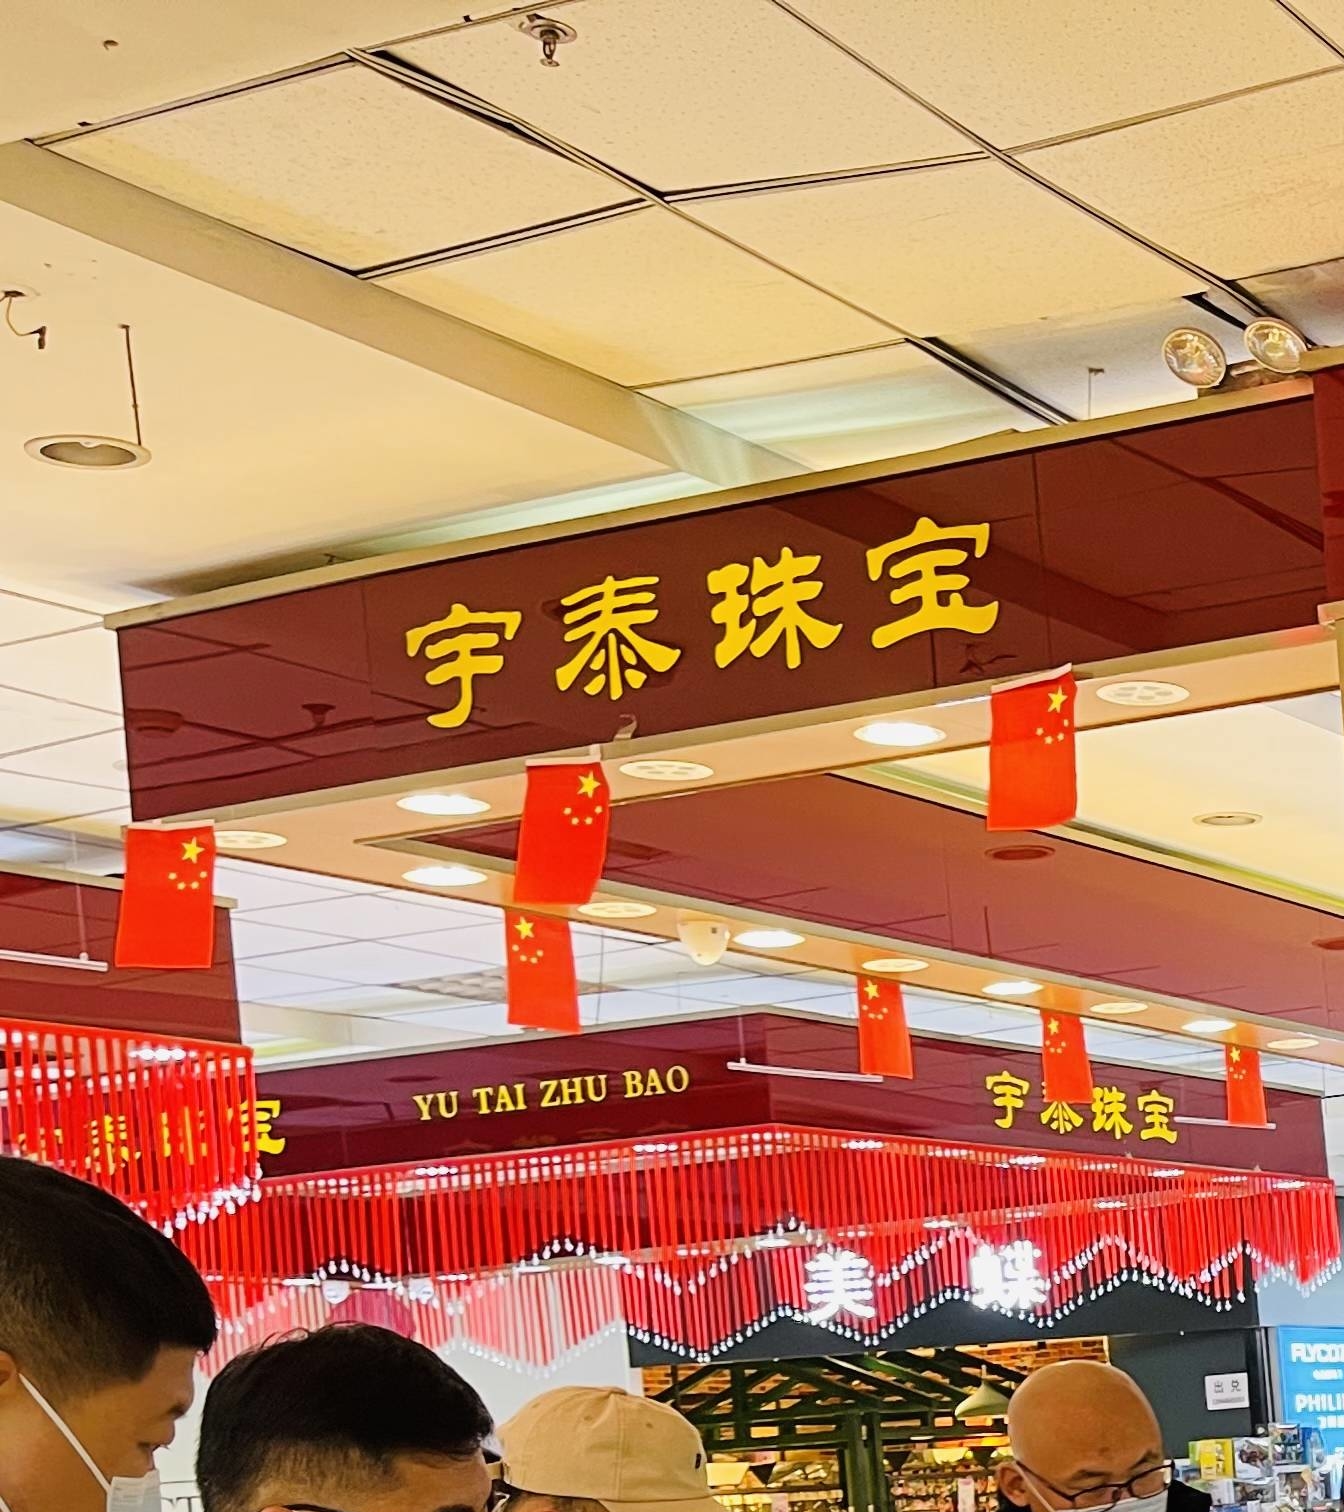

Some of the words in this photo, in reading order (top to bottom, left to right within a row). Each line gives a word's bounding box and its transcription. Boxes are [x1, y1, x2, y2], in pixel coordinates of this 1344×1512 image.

[406, 517, 999, 729] 宇泰珠宝
[413, 1091, 459, 1122] YU
[472, 1084, 527, 1114] TAI
[540, 1076, 607, 1108] ZHU
[624, 1065, 690, 1098] BAO
